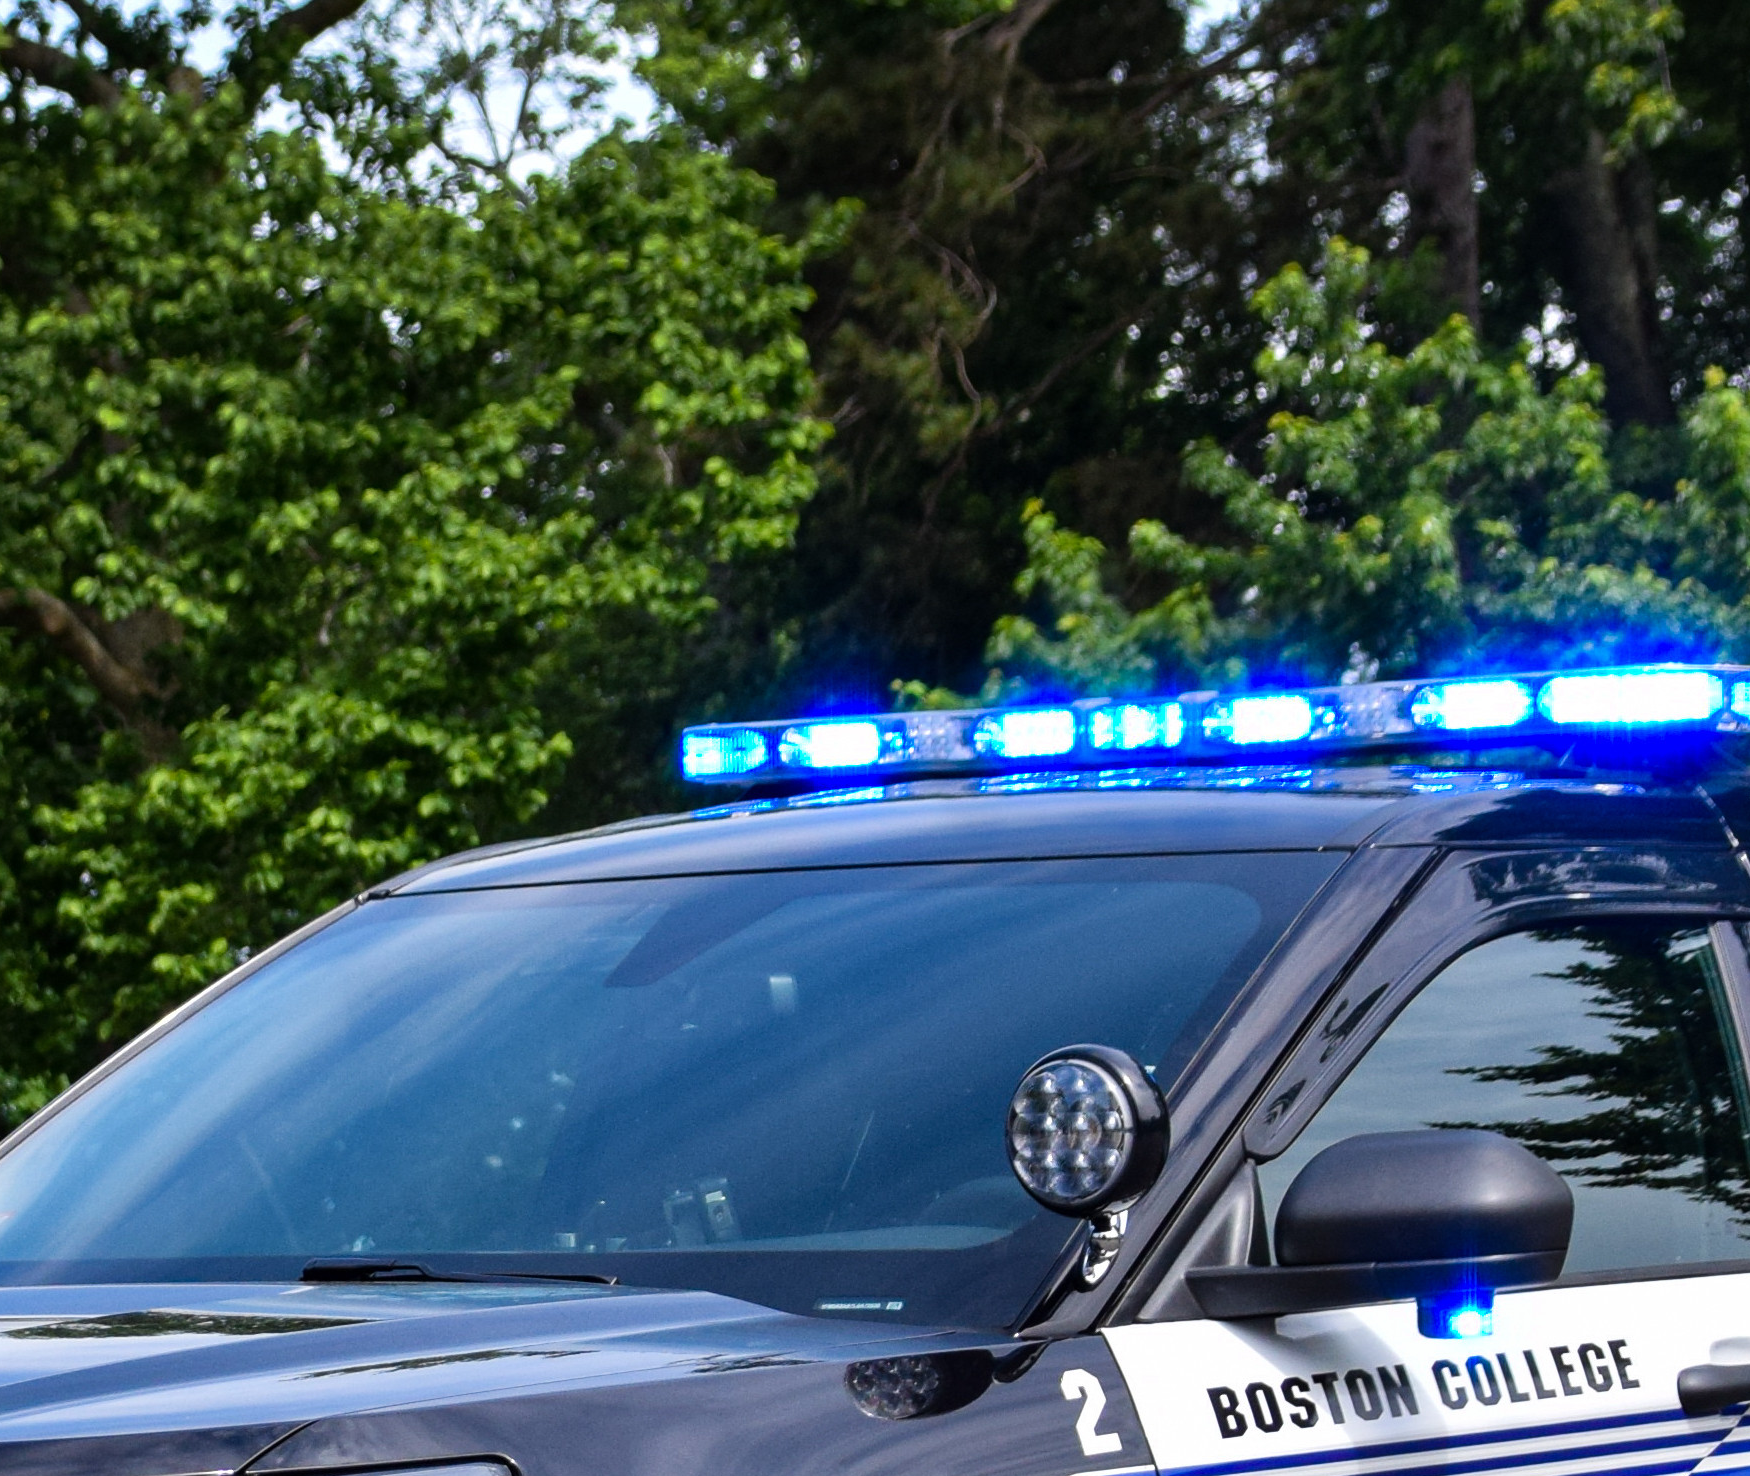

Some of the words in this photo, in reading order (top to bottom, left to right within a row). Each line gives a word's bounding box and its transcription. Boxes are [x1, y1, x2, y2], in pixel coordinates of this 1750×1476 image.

[1060, 1368, 1123, 1457] 2
[1206, 1363, 1421, 1440] BOSTON
[1431, 1339, 1641, 1415] COLLEGE
